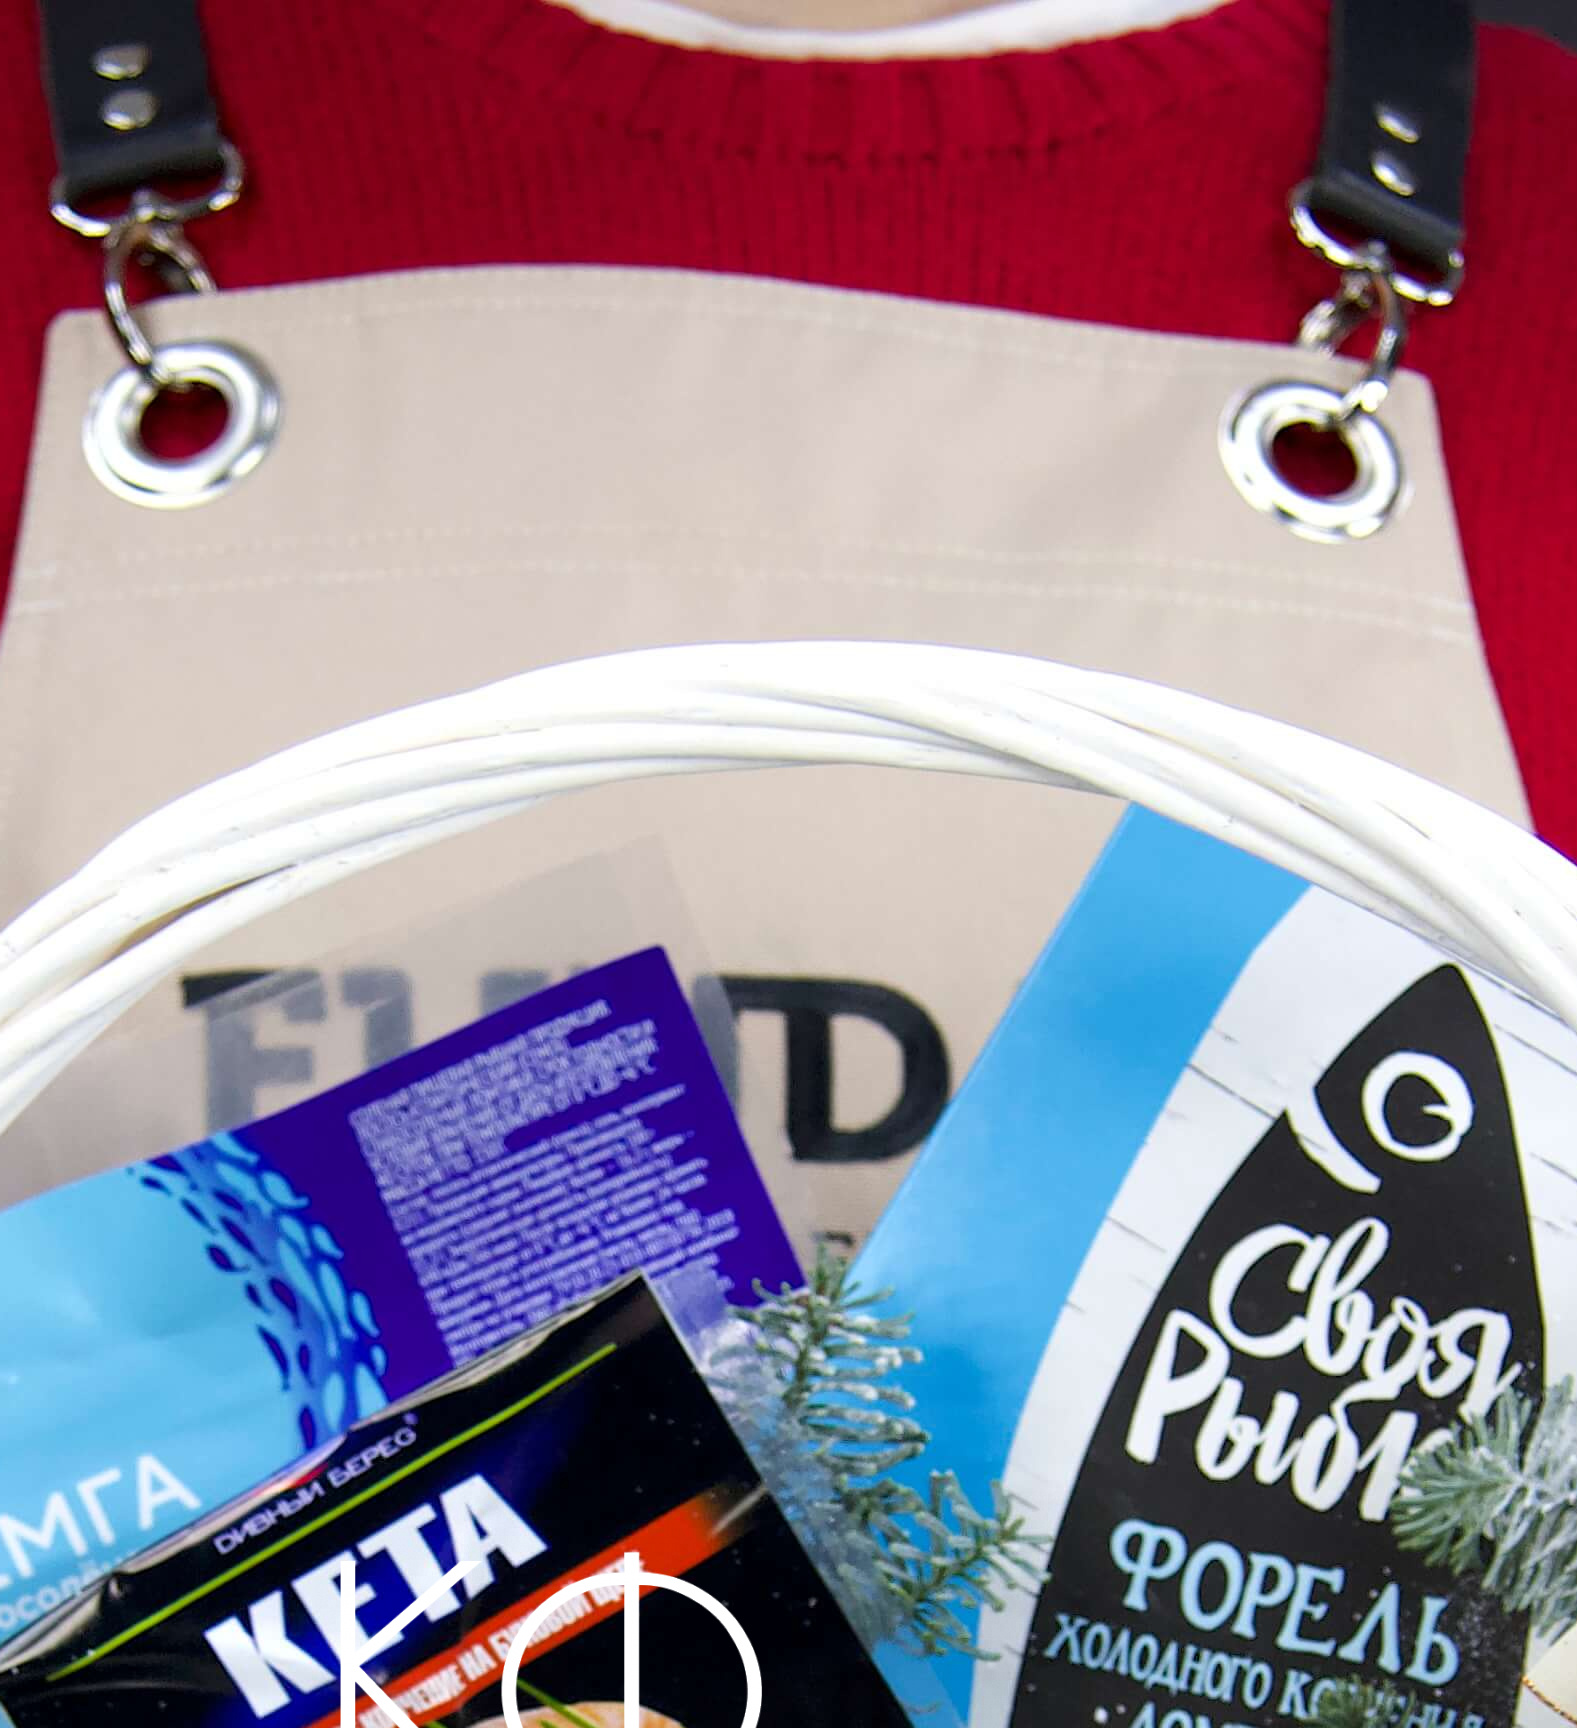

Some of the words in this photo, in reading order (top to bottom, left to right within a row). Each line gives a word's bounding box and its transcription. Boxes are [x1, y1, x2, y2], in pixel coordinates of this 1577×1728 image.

[1210, 1217, 1521, 1420] Своя
[1125, 1309, 1458, 1521] Рыбк
[204, 1473, 548, 1718] КЕТА
[457, 1640, 495, 1682] НА
[1045, 1613, 1273, 1703] ХОЛОДНОГО
[1110, 1519, 1460, 1686] ФОРЕЛЬ
